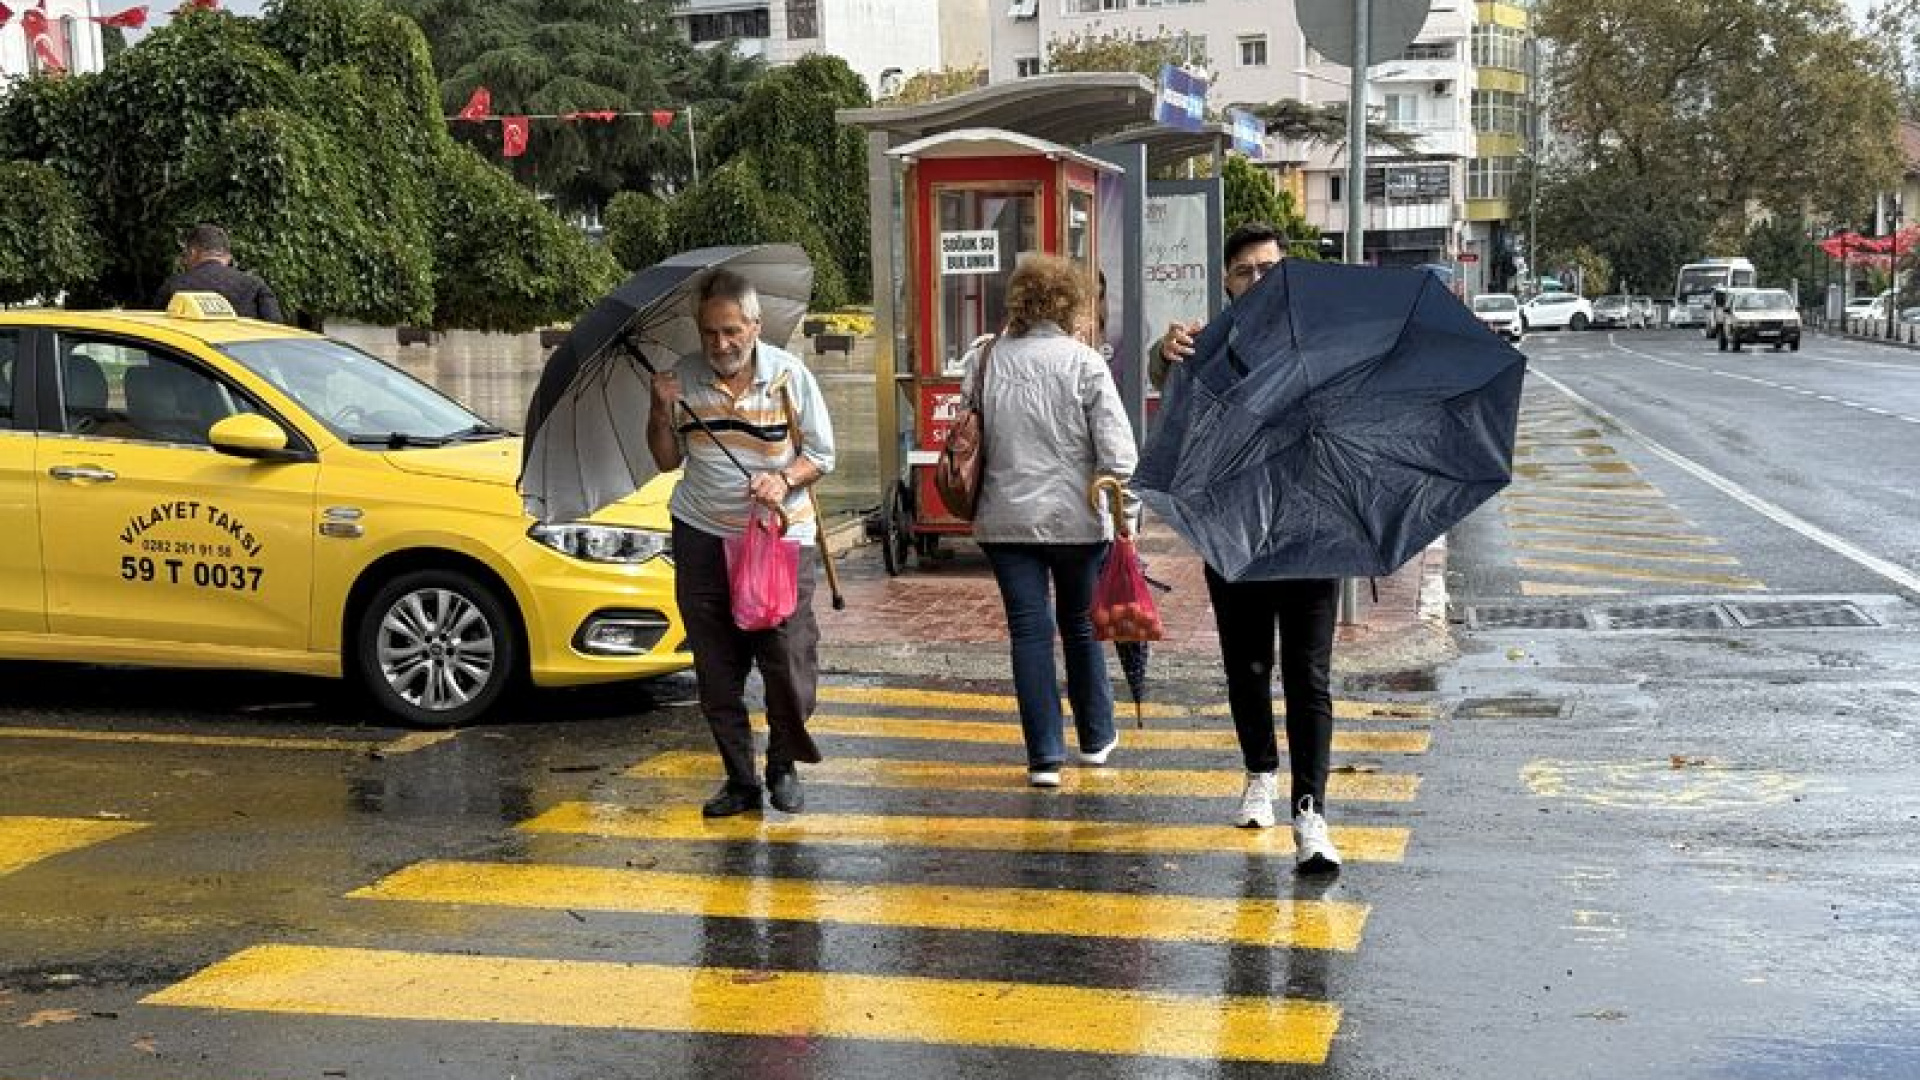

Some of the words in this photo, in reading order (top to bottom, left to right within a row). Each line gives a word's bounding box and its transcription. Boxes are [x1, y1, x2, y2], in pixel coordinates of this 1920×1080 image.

[980, 237, 993, 250] SU
[947, 254, 994, 270] BULUNUR
[121, 556, 155, 581] 59
[165, 558, 183, 584] T
[193, 562, 264, 591] 0037
